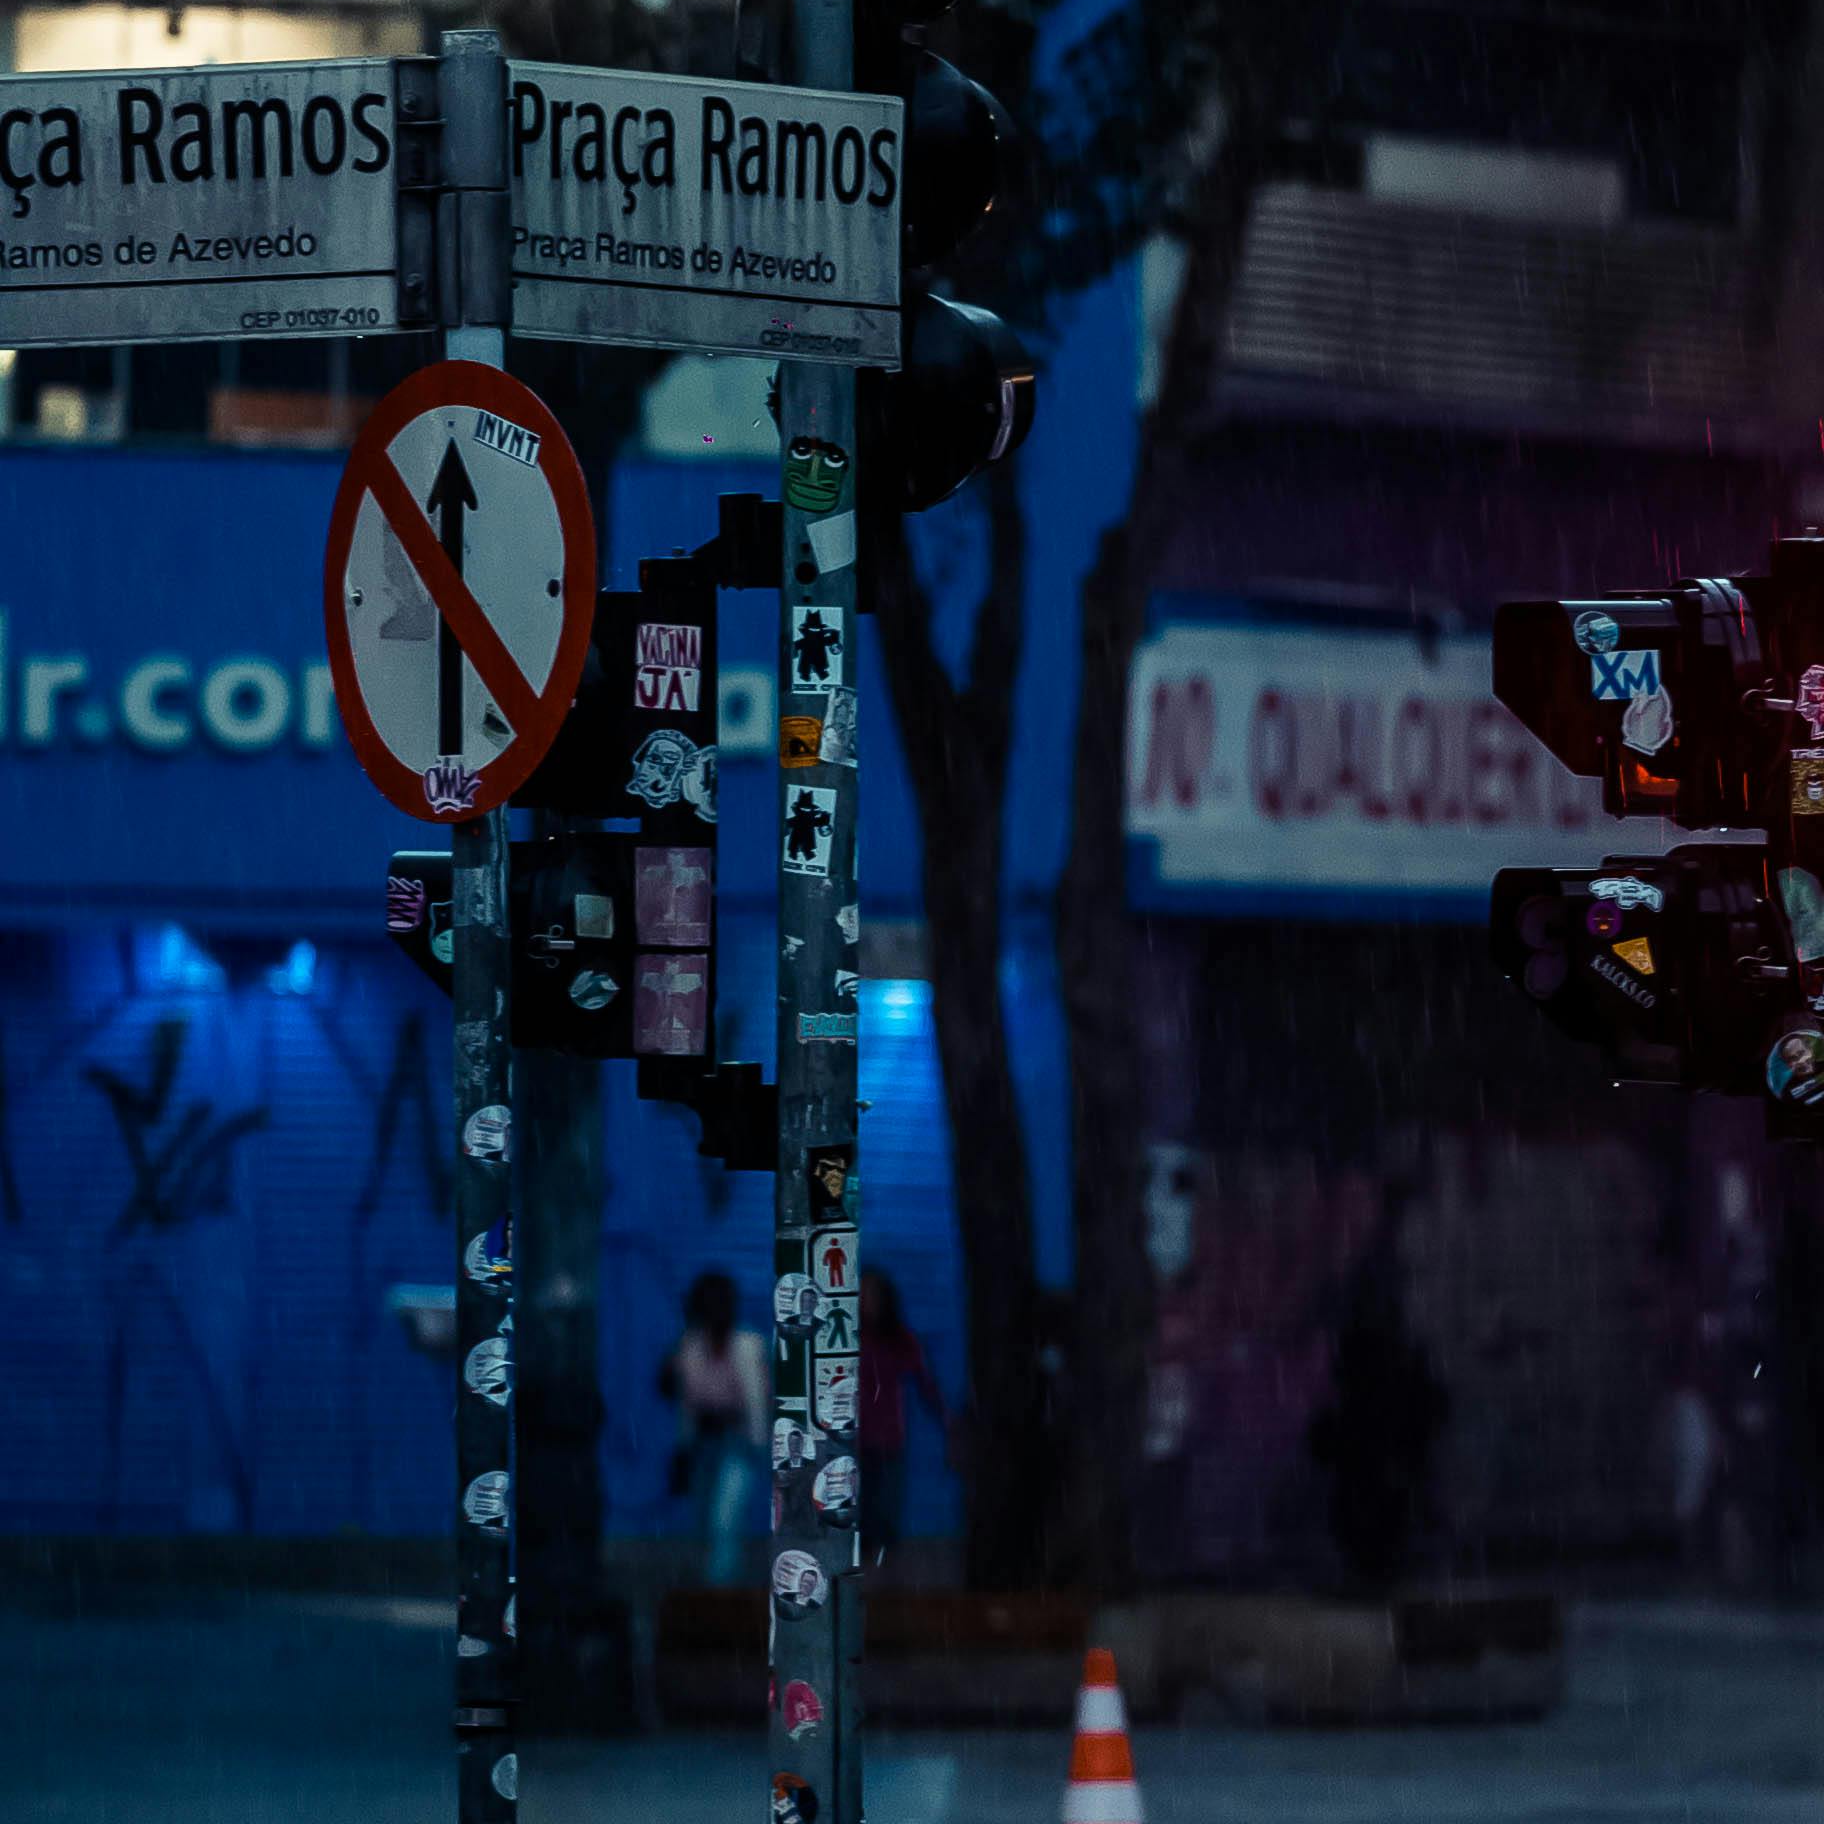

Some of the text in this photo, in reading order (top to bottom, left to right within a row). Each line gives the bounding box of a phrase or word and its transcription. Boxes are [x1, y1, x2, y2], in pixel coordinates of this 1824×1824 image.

[119, 87, 390, 184] Ramos
[512, 82, 897, 214] Praça Ramos
[115, 235, 156, 264] de
[168, 228, 317, 264] Azevedo
[512, 227, 836, 283] Praça Ramos de Azevedo
[241, 308, 381, 328] CEP 01037-010
[476, 411, 539, 463] INVNT
[1593, 651, 1658, 698] XM
